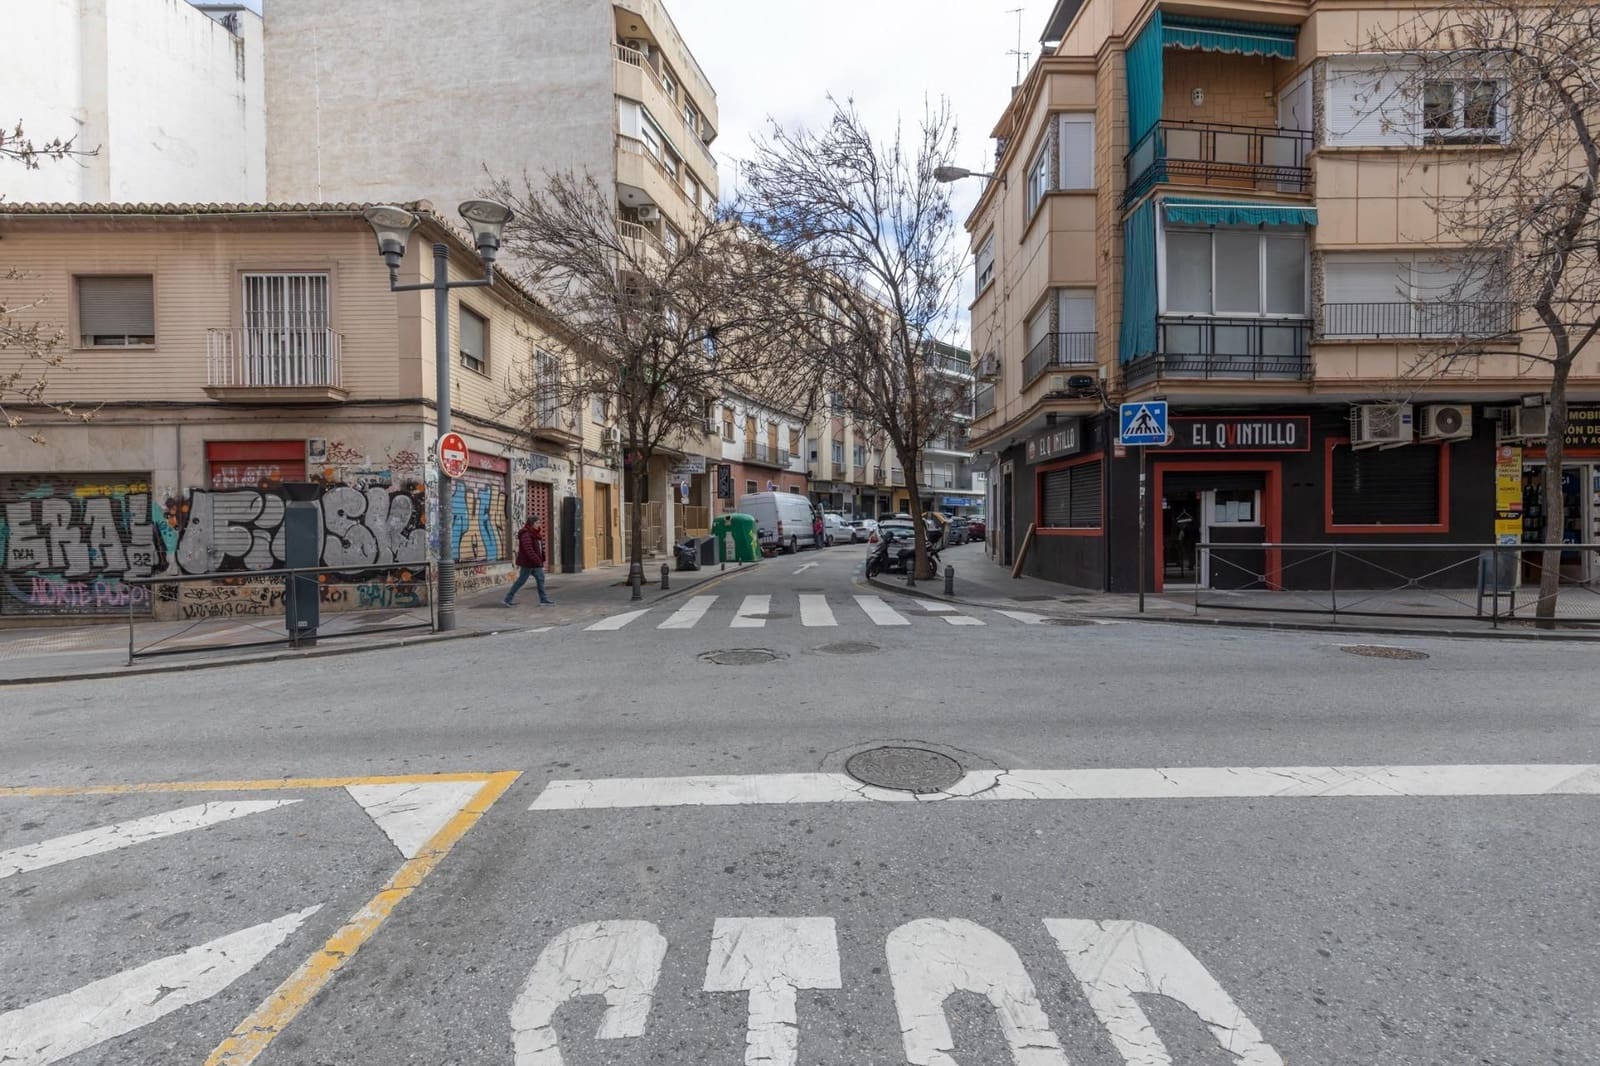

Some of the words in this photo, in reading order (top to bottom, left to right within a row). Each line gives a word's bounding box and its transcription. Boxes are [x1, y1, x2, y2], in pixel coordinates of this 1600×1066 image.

[1568, 411, 1600, 420] MOBI
[1193, 423, 1211, 446] EL
[1216, 423, 1296, 448] QVINTILLO
